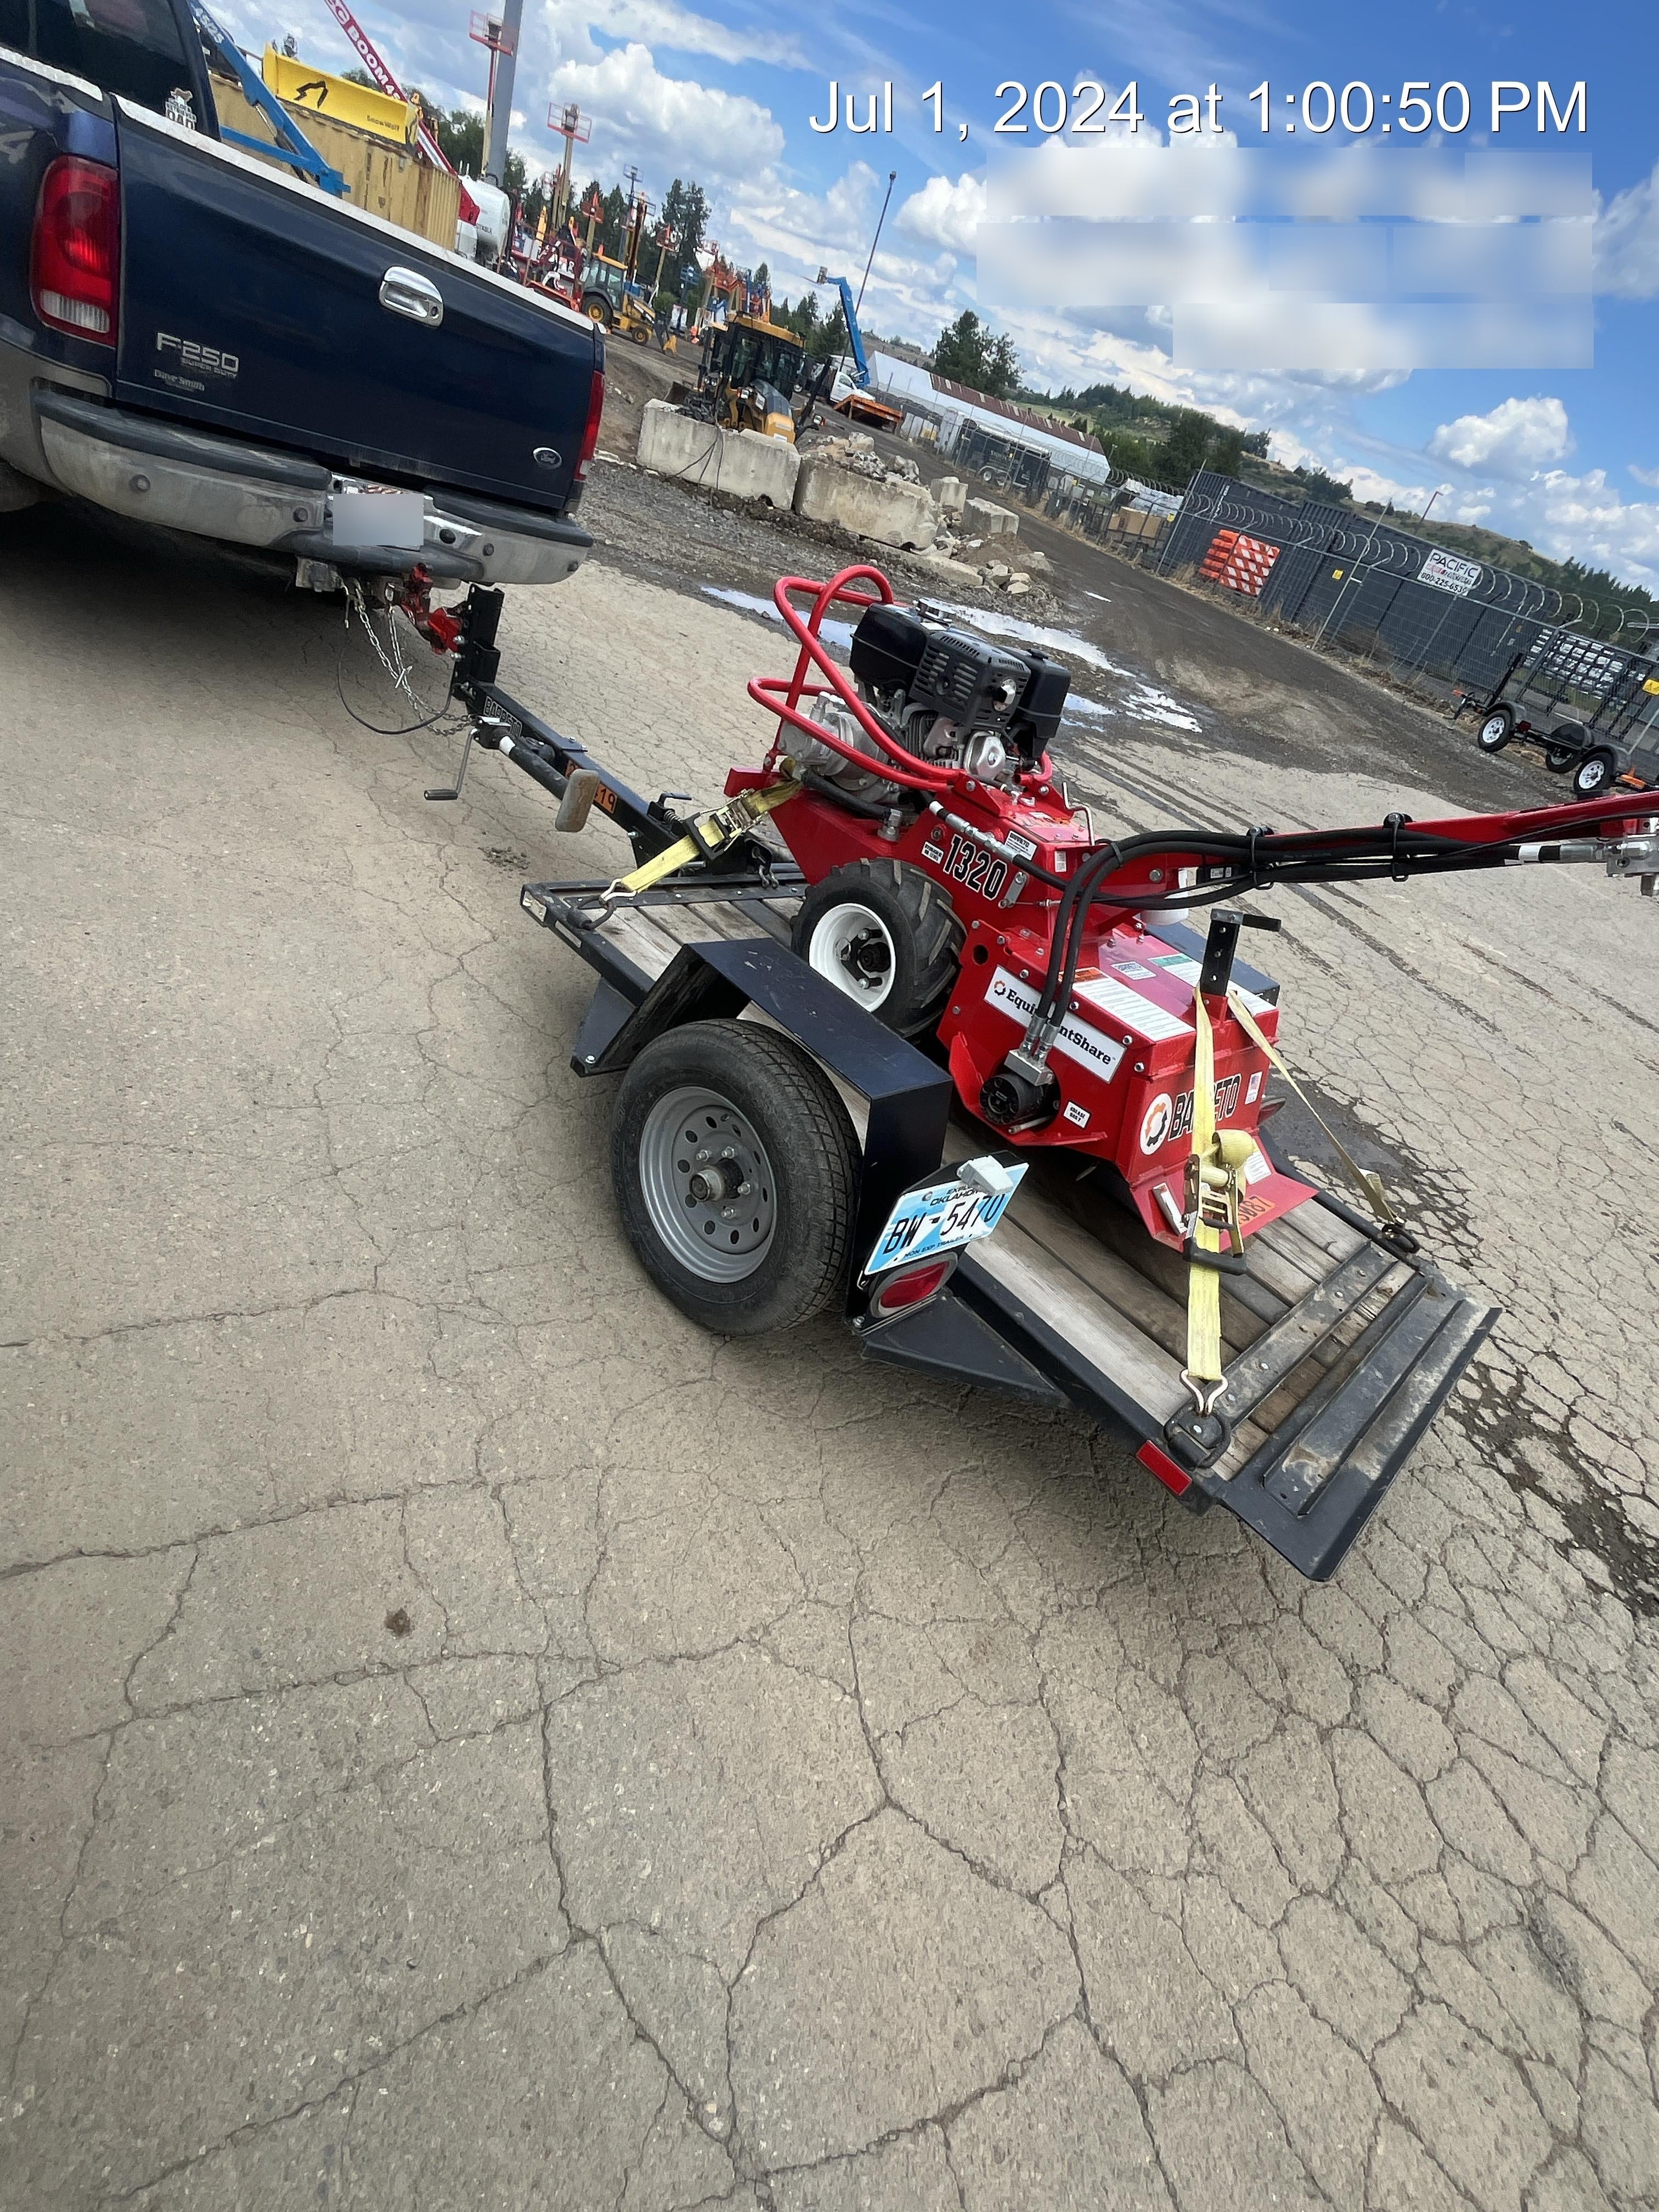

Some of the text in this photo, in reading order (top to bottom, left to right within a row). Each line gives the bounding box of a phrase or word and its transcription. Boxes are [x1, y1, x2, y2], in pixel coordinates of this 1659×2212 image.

[1429, 552, 1479, 579] PACIFIC
[943, 834, 1007, 901] 1320
[936, 1235, 964, 1248] TRAILER
